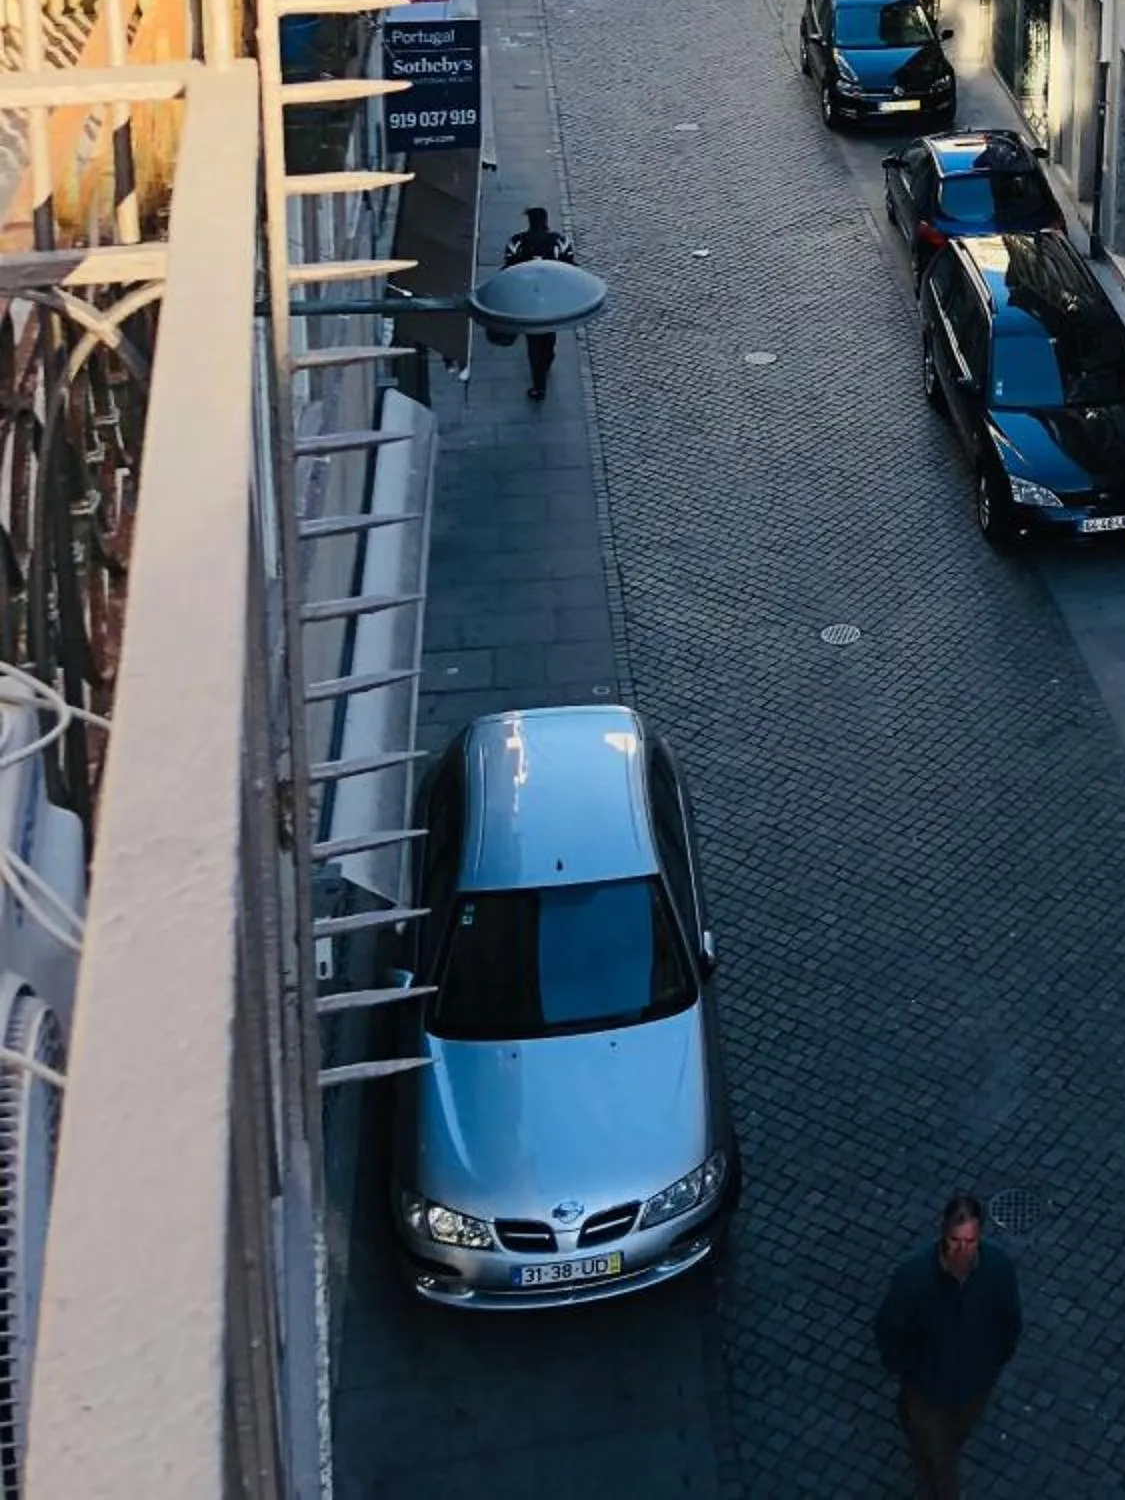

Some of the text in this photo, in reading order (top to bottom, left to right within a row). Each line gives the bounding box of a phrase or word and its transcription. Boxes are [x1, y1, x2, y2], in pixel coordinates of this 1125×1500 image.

[391, 28, 456, 46] Portugal
[392, 56, 473, 75] Sotheby's
[389, 108, 477, 129] 919 037 919
